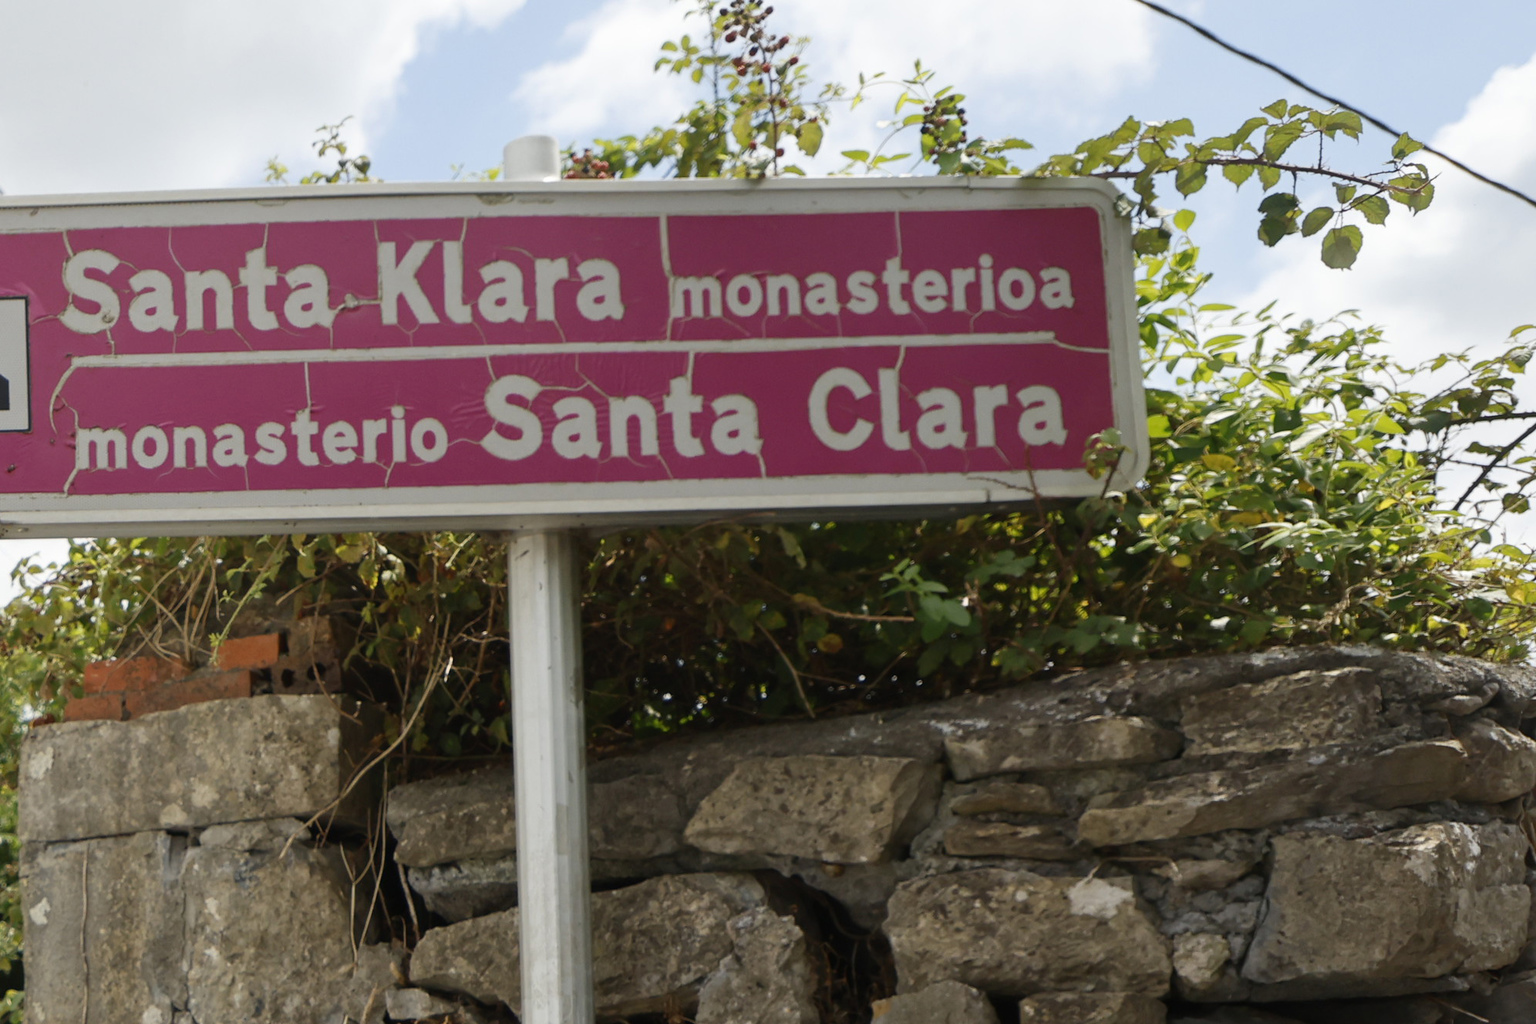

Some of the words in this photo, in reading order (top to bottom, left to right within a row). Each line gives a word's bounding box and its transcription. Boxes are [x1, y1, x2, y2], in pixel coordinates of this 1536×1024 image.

[60, 247, 334, 335] Santa
[378, 239, 625, 326] Klara
[672, 253, 1075, 318] monasterioa
[76, 405, 449, 470] monasterio
[481, 374, 763, 461] Santa
[808, 366, 1068, 451] Clara
